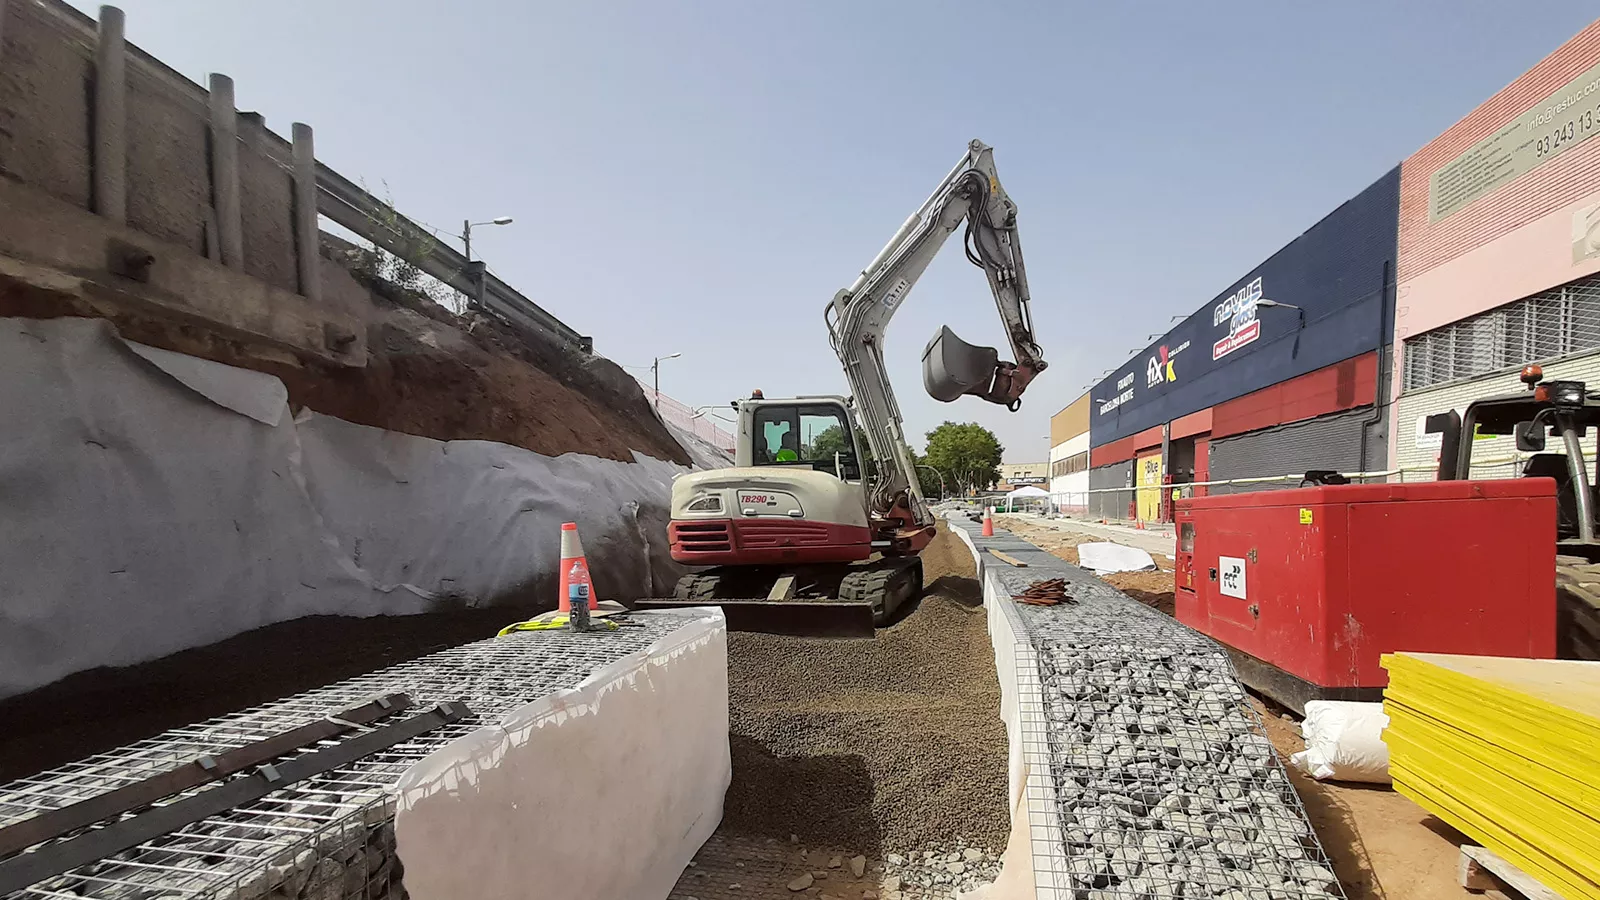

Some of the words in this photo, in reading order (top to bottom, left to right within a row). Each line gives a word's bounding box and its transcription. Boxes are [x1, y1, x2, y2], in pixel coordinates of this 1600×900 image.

[1536, 136, 1549, 157] 93
[1554, 121, 1574, 148] 243
[1578, 110, 1592, 133] 13
[741, 495, 767, 503] TB290
